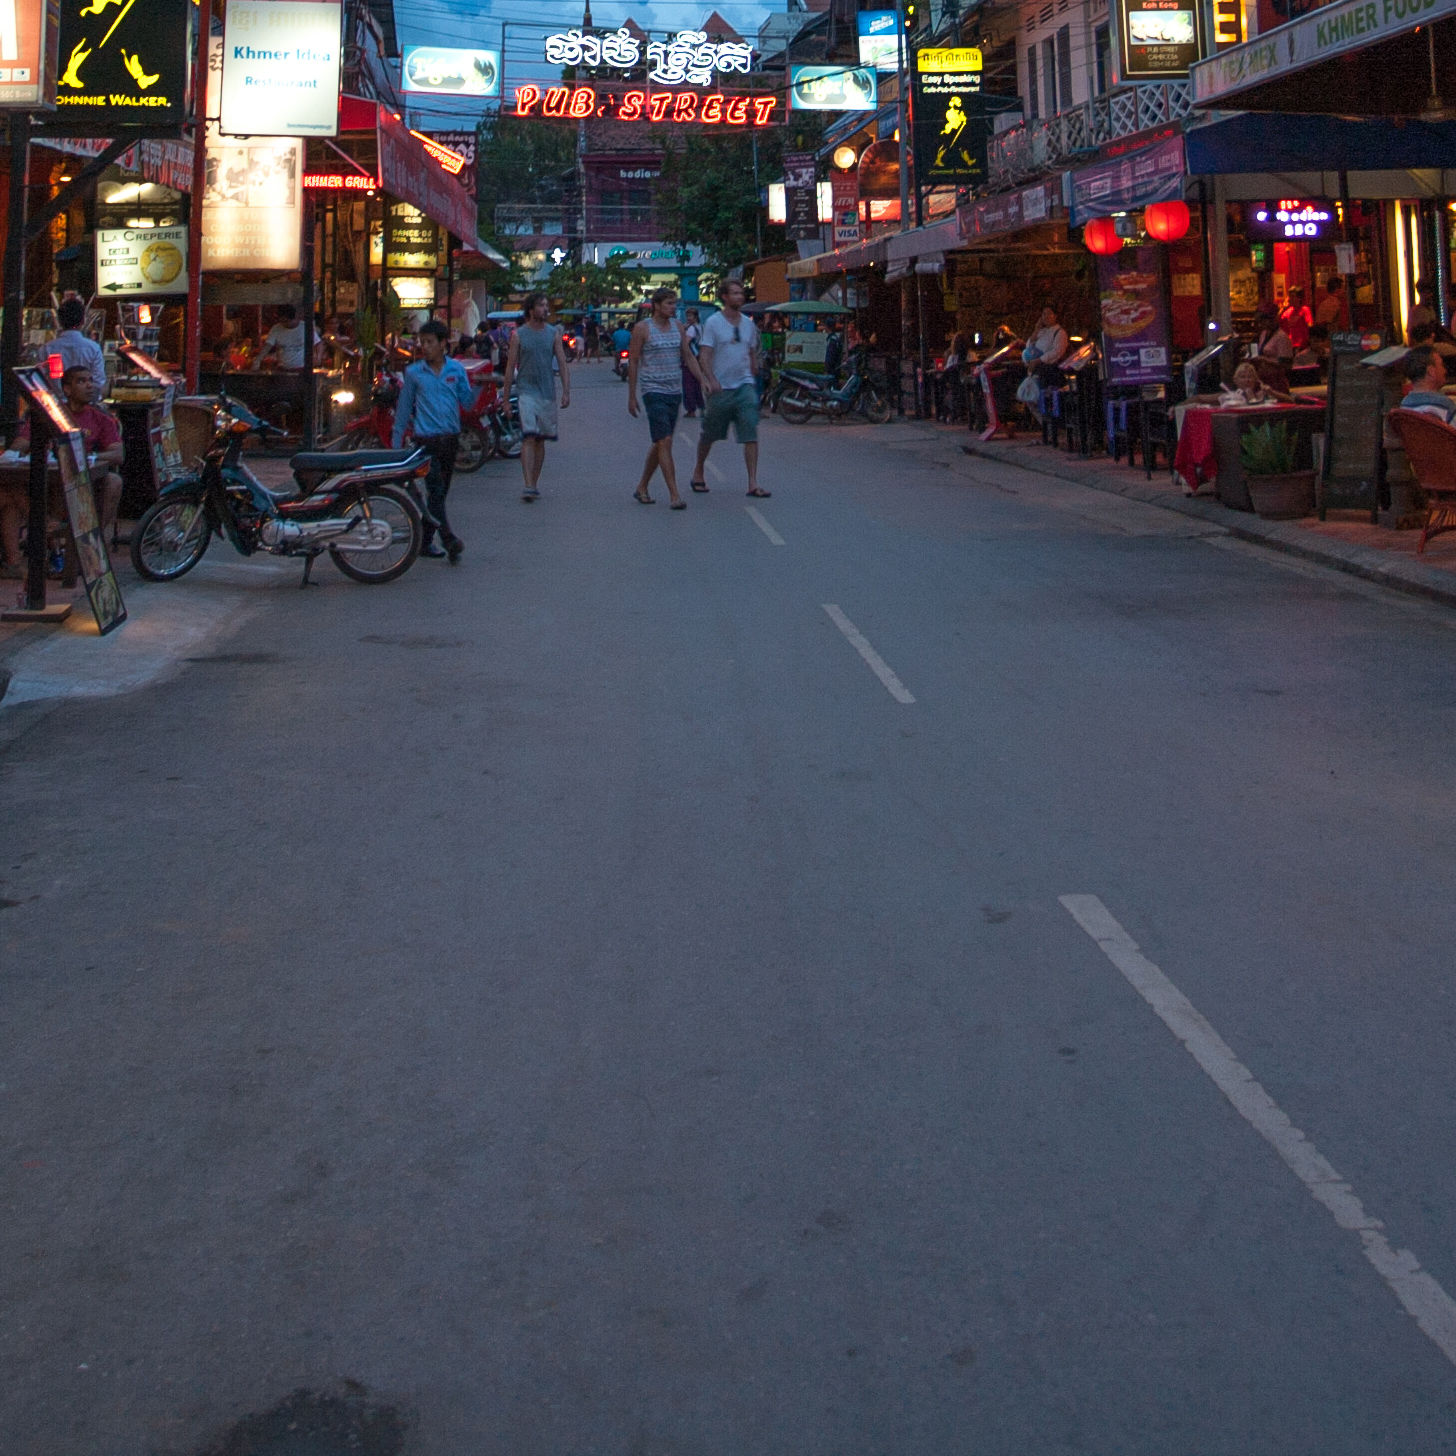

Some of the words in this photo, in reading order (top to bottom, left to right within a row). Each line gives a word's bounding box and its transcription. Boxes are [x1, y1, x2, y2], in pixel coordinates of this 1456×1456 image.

[1159, 2, 1179, 10] Kong
[1316, 5, 1379, 48] KHMER
[234, 46, 290, 60] Khmer
[922, 74, 942, 85] Easy
[944, 74, 981, 85] Speaking
[56, 95, 106, 106] OHNNIE
[515, 84, 595, 118] PUB
[619, 90, 776, 126] STREET
[304, 176, 342, 187] KHMER
[345, 176, 376, 189] GRILL
[124, 230, 183, 241] CREPERIE
[837, 230, 857, 238] VISA
